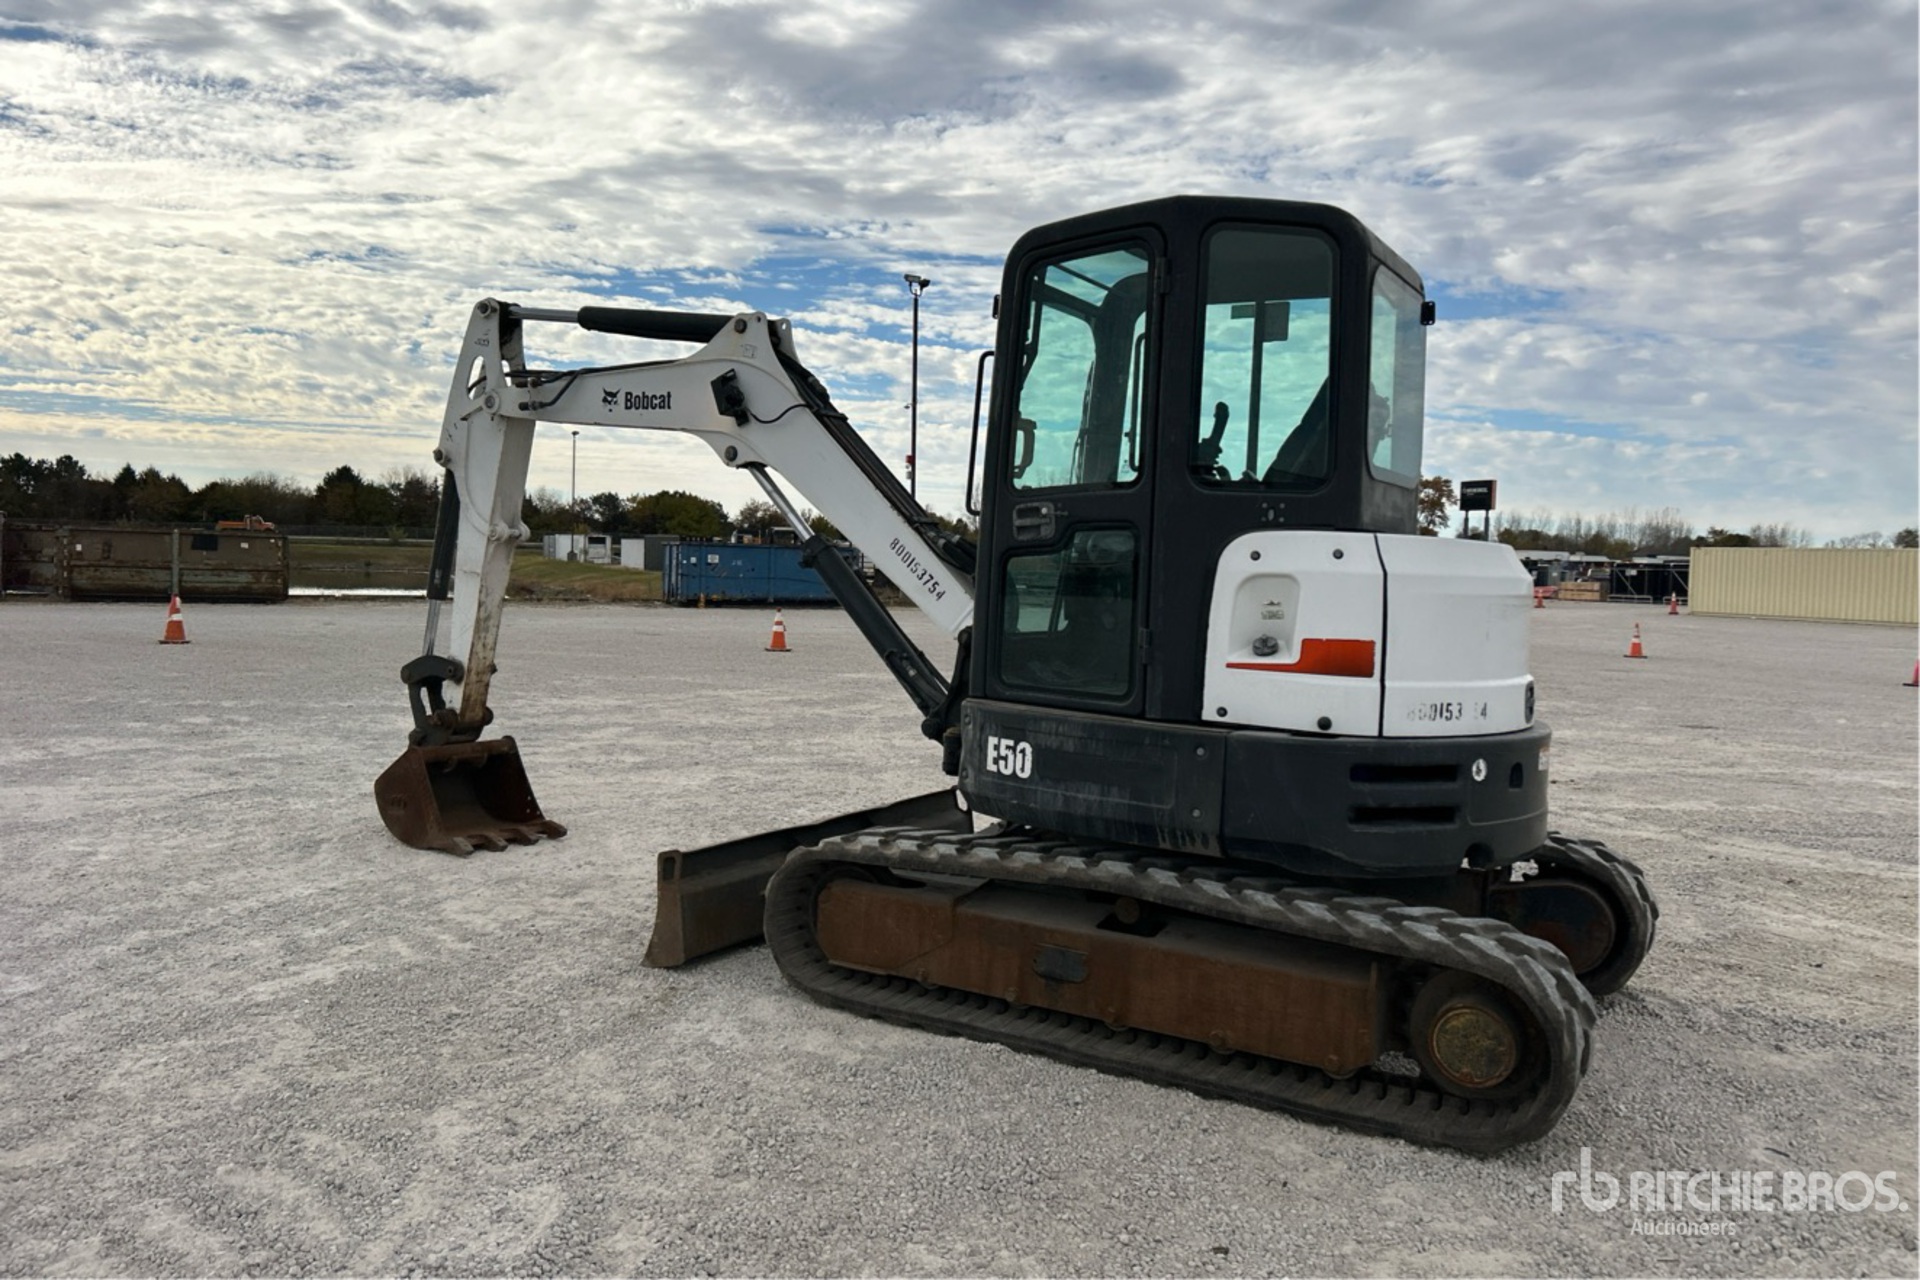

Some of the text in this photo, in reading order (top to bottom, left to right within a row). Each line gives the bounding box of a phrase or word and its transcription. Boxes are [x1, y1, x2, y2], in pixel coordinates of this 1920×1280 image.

[624, 391, 672, 410] Bobcat
[889, 537, 946, 601] 800153754
[986, 735, 1033, 779] E50
